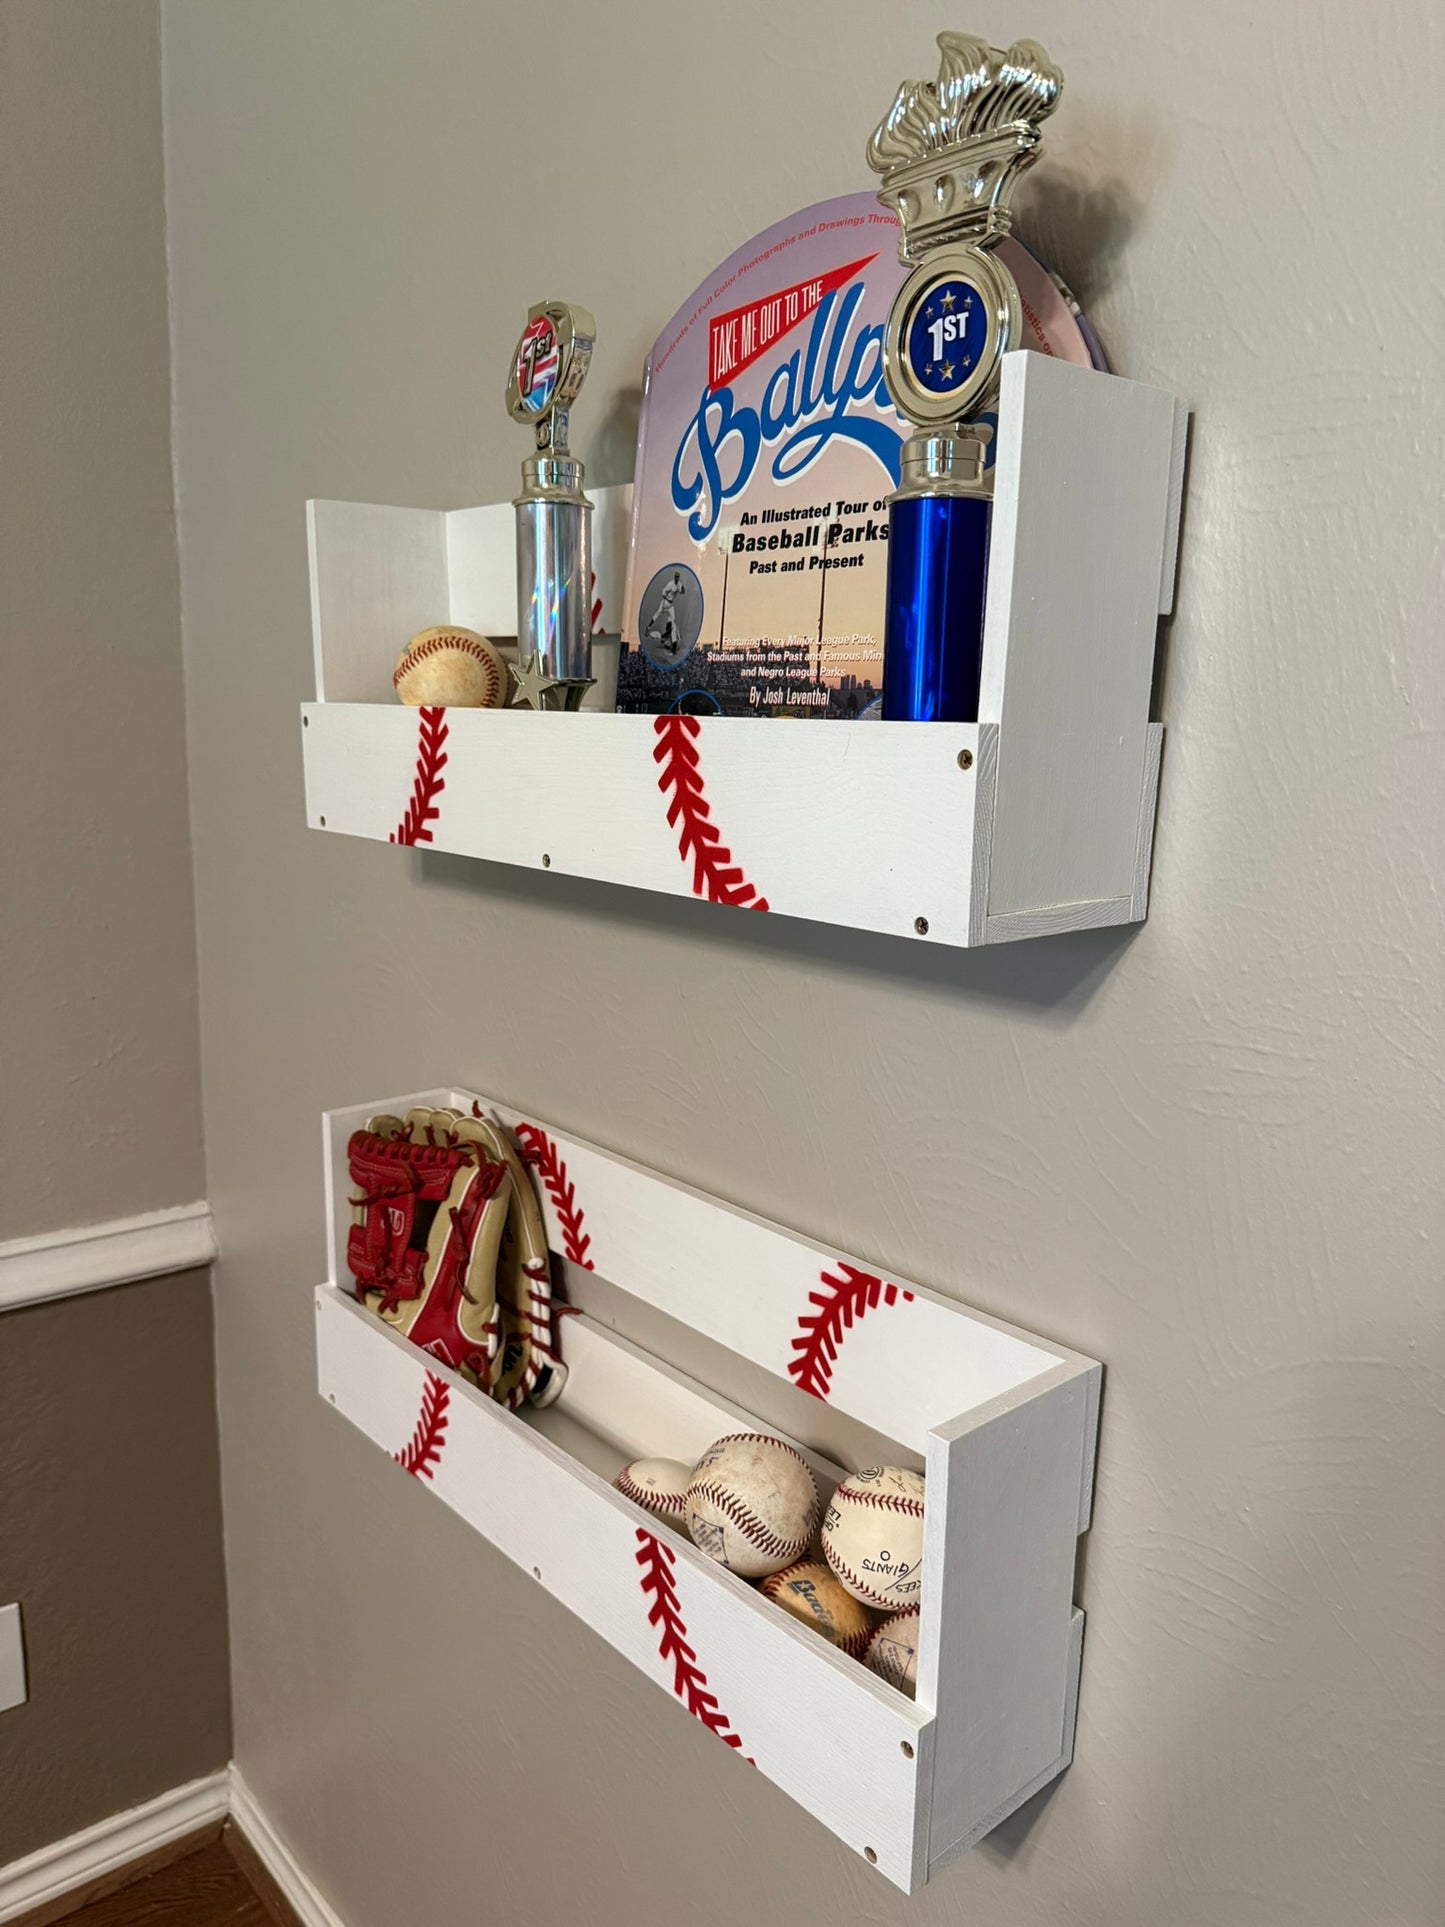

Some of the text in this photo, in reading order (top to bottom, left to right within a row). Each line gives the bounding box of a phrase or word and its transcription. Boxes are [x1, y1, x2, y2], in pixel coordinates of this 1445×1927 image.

[654, 213, 901, 374] Hundreds of Full Color Photographs and Drawings Throug
[712, 279, 823, 382] TAKE ME OUT TO THE
[928, 311, 969, 362] 1ST
[671, 282, 904, 543] Ballp
[740, 511, 758, 526] An
[762, 502, 831, 524] Illustrated
[835, 499, 868, 517] Tour
[732, 519, 889, 553] Baseball Parks
[749, 552, 864, 574] Past and Present
[722, 633, 877, 649] Featuring Every Major League Park,
[707, 649, 884, 662] Stadiums from the Past and Famous Min
[740, 666, 847, 679] and Negro League Parks
[749, 686, 831, 706] By Josh Leventhal
[861, 1558, 910, 1578] GIANTS
